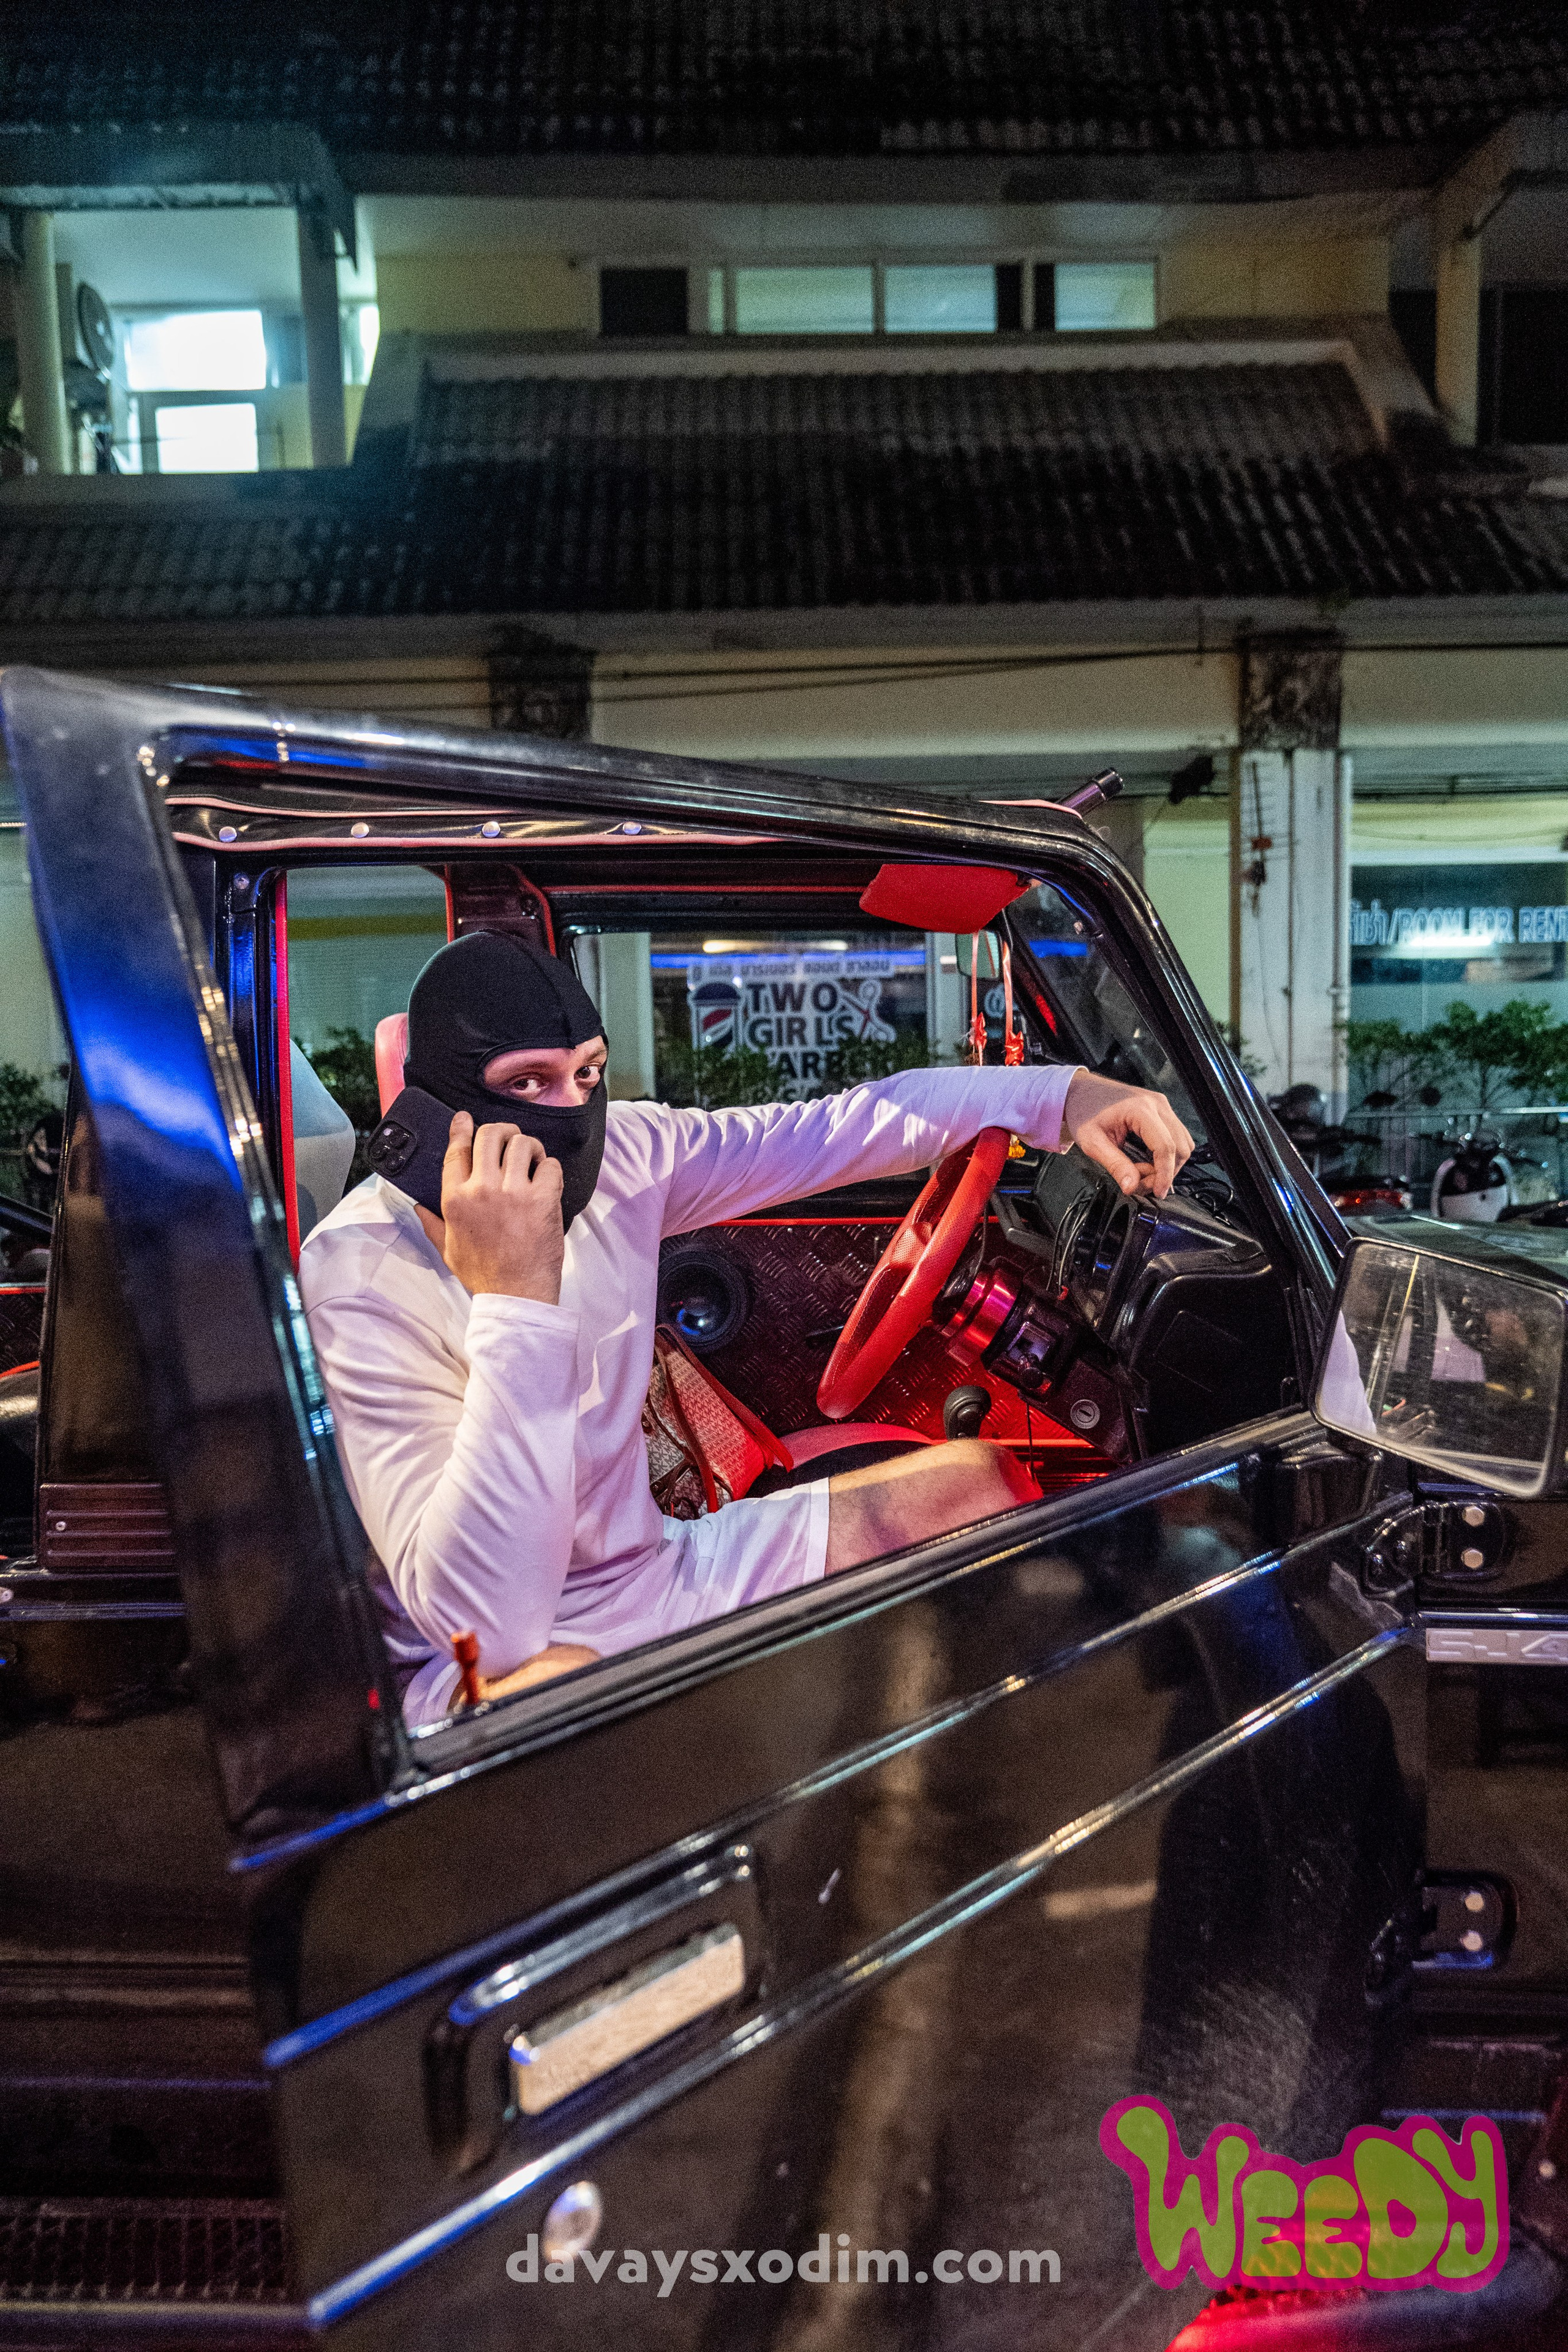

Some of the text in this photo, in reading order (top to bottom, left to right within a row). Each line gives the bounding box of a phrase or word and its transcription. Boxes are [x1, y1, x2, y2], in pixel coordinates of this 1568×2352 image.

[1469, 907, 1514, 943] FOR
[745, 982, 838, 1012] TWO
[748, 1015, 855, 1046] GIRLS
